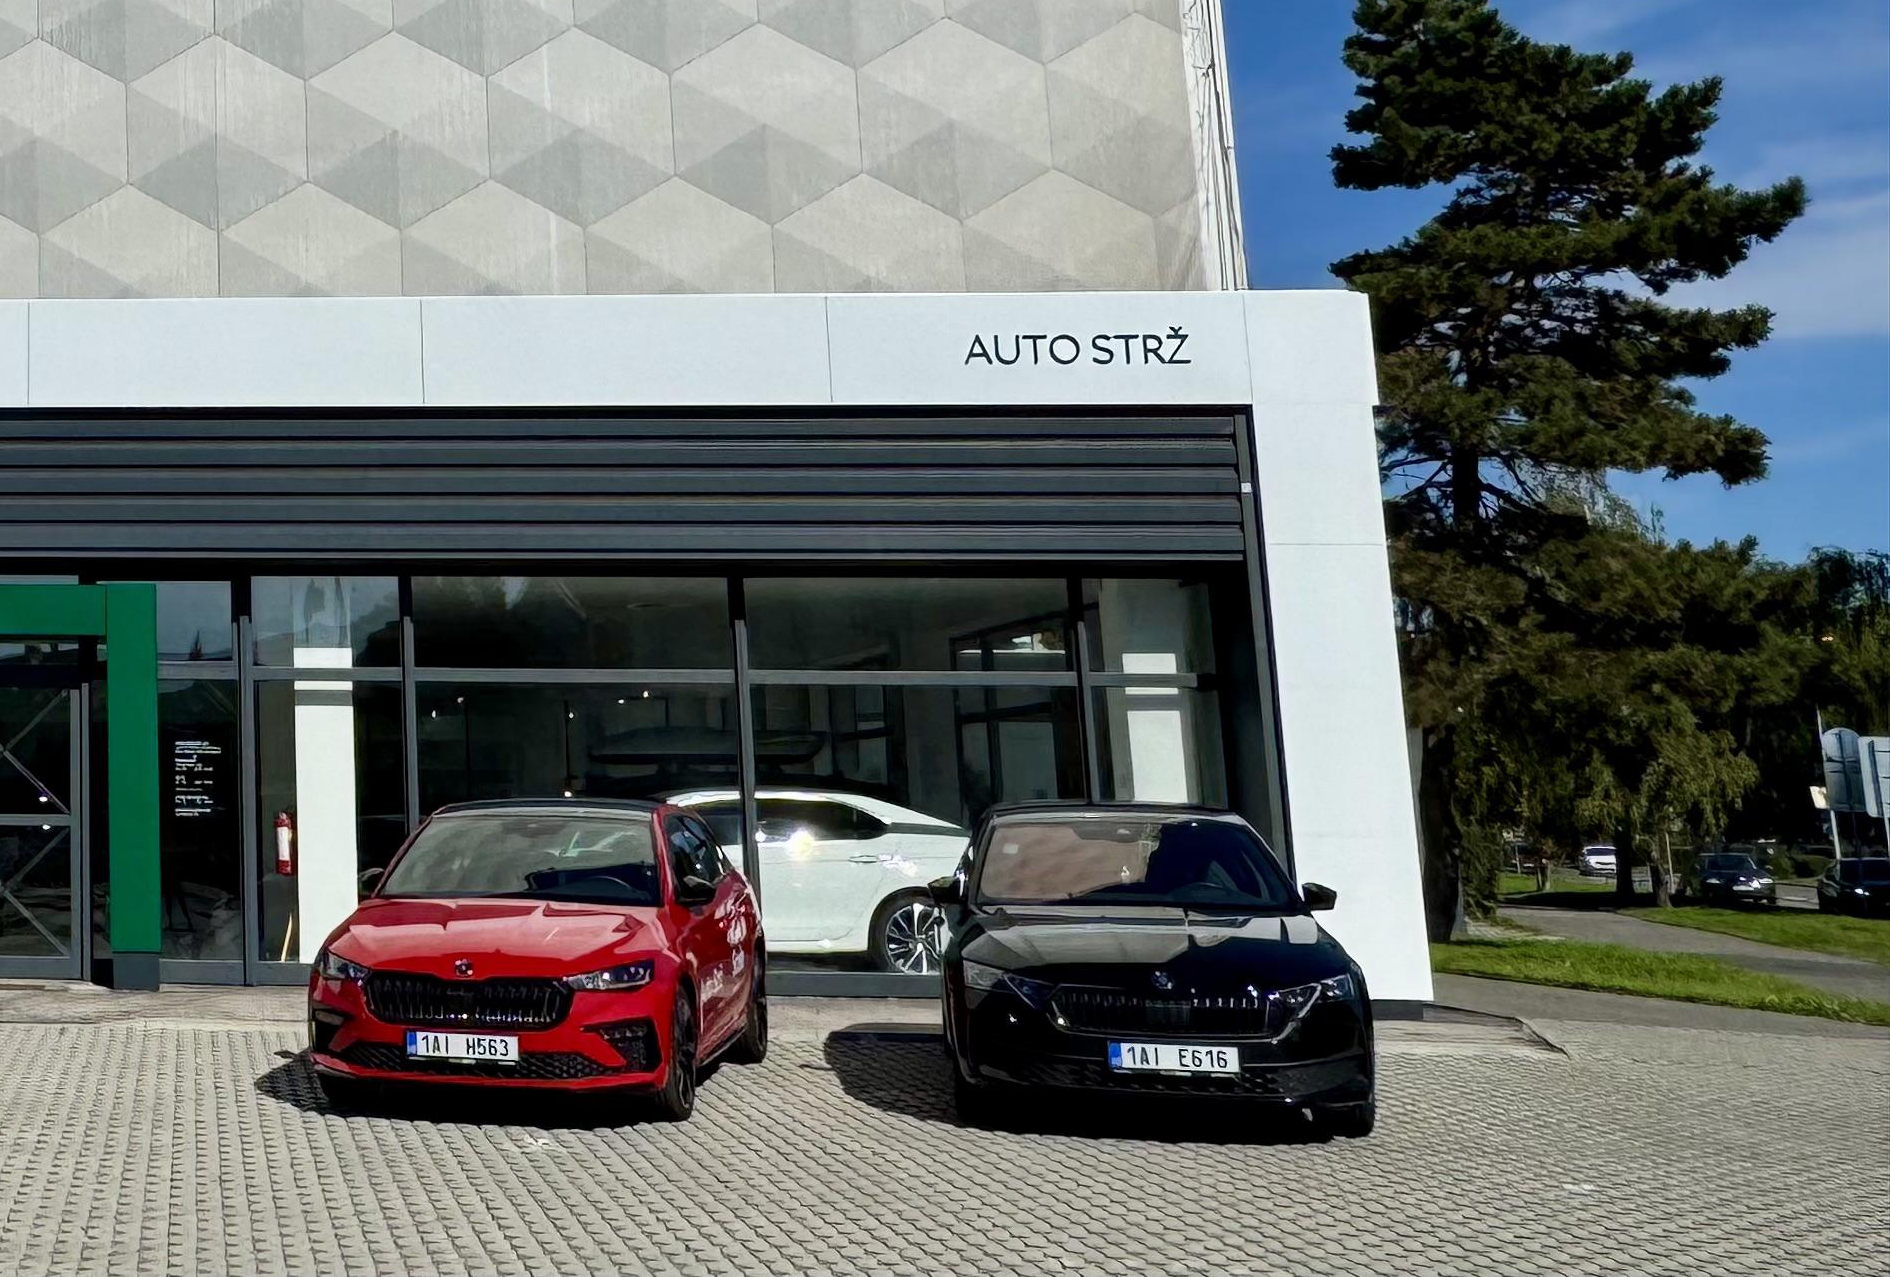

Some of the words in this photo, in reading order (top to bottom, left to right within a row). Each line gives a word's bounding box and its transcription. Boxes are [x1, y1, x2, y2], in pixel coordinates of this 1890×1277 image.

[964, 333, 1080, 365] AUTO
[1091, 325, 1192, 365] STRŽ
[465, 1037, 509, 1057] H563
[1127, 1046, 1159, 1067] 1AI
[1178, 1048, 1228, 1069] E616
